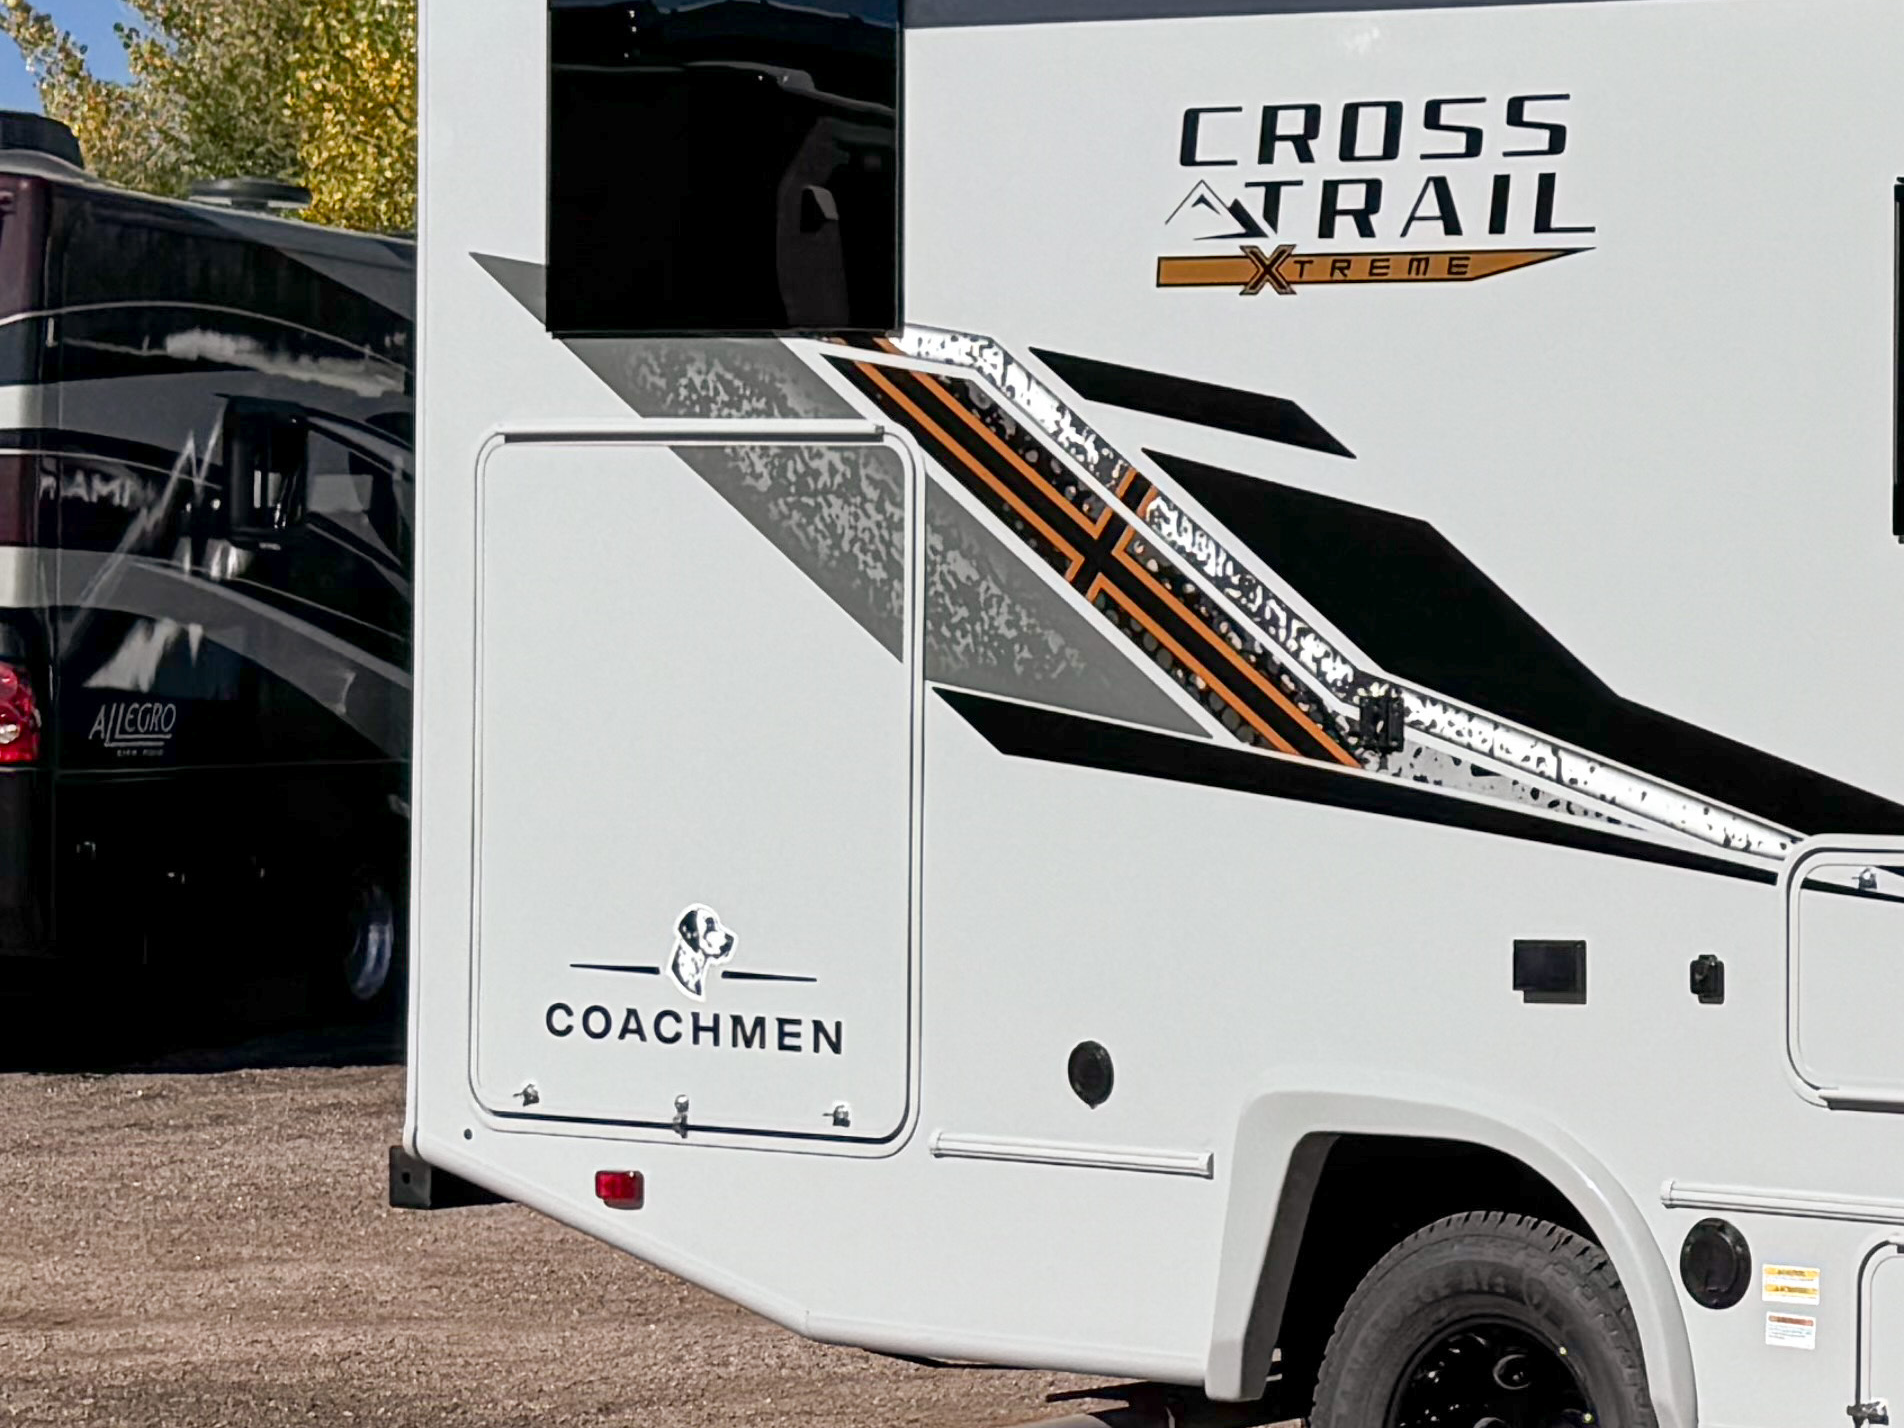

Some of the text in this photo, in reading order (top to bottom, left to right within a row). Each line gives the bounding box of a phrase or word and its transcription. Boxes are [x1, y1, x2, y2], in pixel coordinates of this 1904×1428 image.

[1179, 93, 1571, 167] CROSS
[1244, 172, 1597, 239] TRAIL
[1239, 244, 1472, 296] XTREME
[88, 702, 177, 746] ALLEGRO
[546, 1002, 843, 1055] COACHMEN
